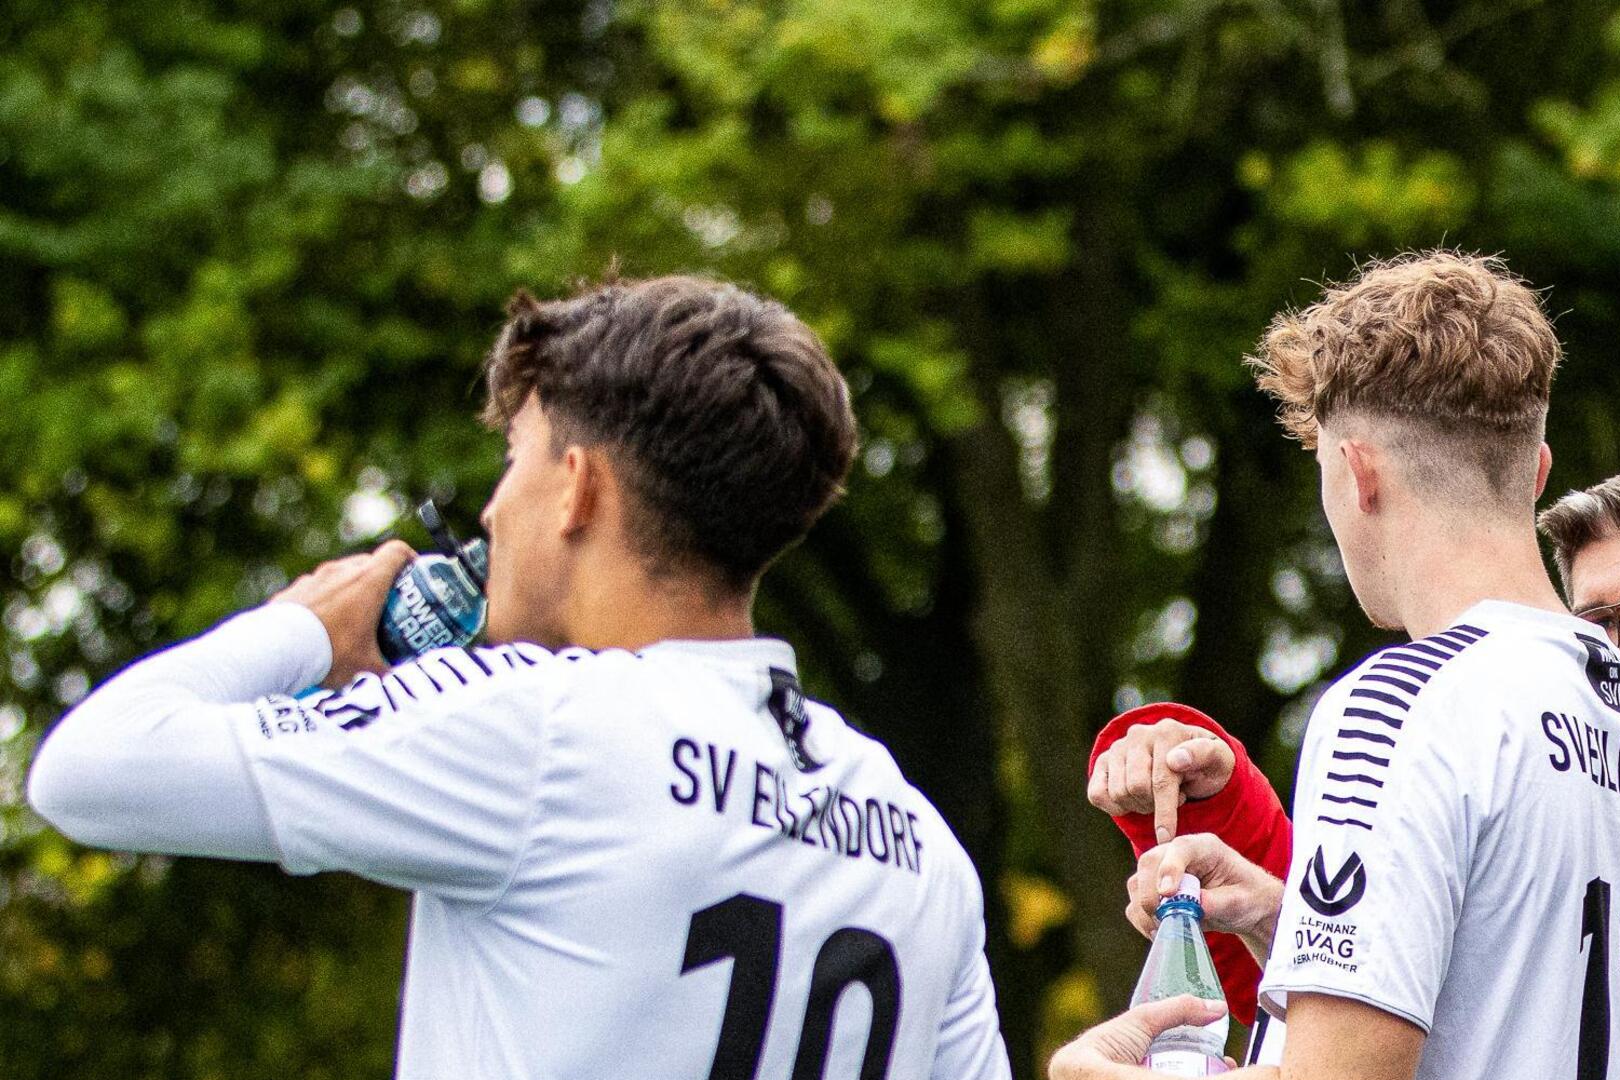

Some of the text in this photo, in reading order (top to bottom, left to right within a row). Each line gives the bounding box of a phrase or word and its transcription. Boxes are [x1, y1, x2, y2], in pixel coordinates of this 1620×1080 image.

[397, 575, 454, 647] POWER
[1541, 711, 1587, 773] SV
[670, 737, 738, 814] SV
[1295, 929, 1354, 959] DVAG
[1311, 952, 1359, 973] HÜBNER
